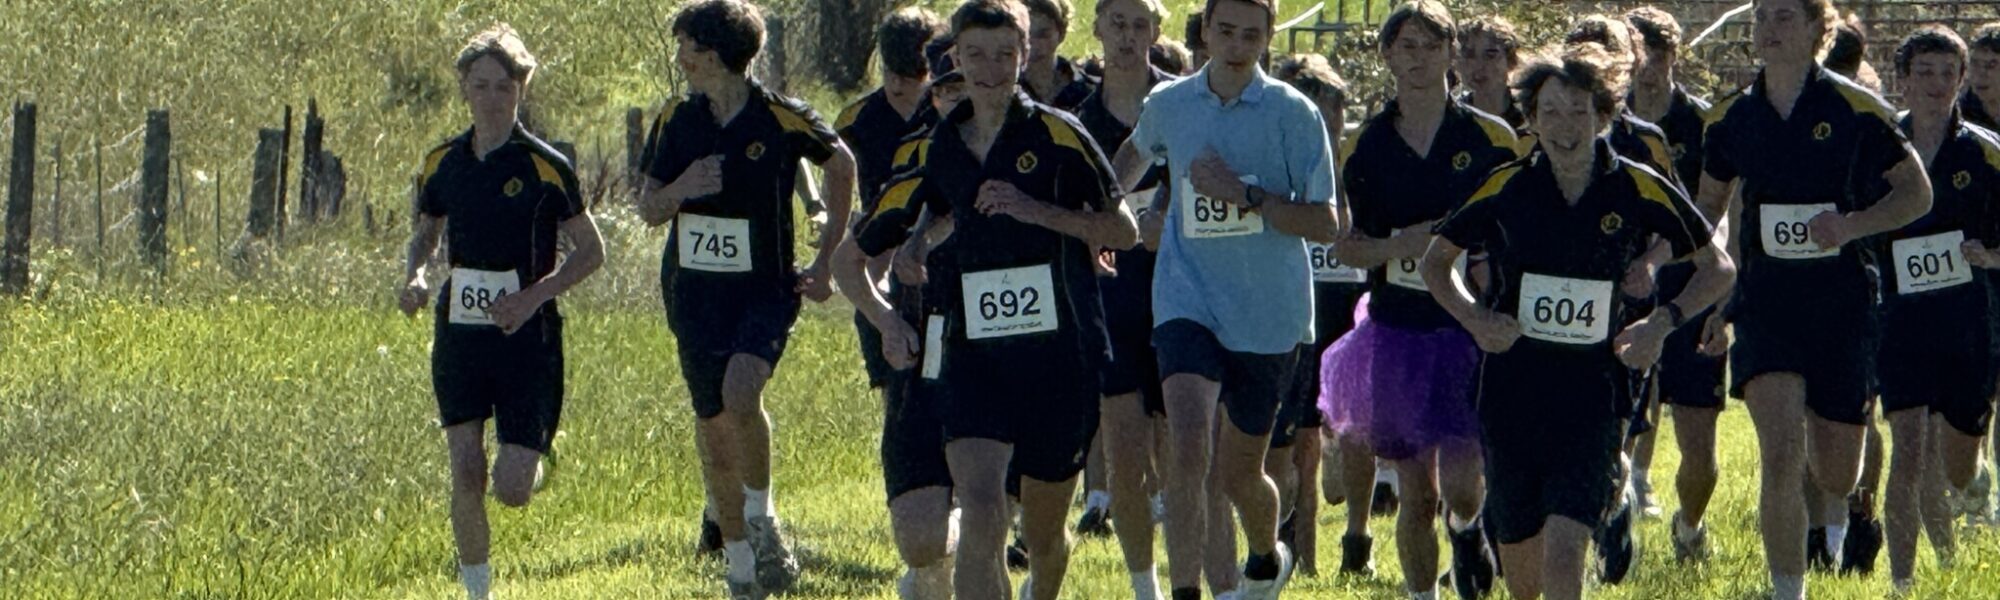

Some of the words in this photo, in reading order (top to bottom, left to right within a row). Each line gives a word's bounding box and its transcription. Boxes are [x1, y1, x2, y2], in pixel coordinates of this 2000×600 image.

[688, 231, 738, 258] 745
[1774, 221, 1808, 245] 69
[1907, 249, 1954, 278] 601
[979, 286, 1041, 321] 692
[1533, 295, 1596, 327] 604
